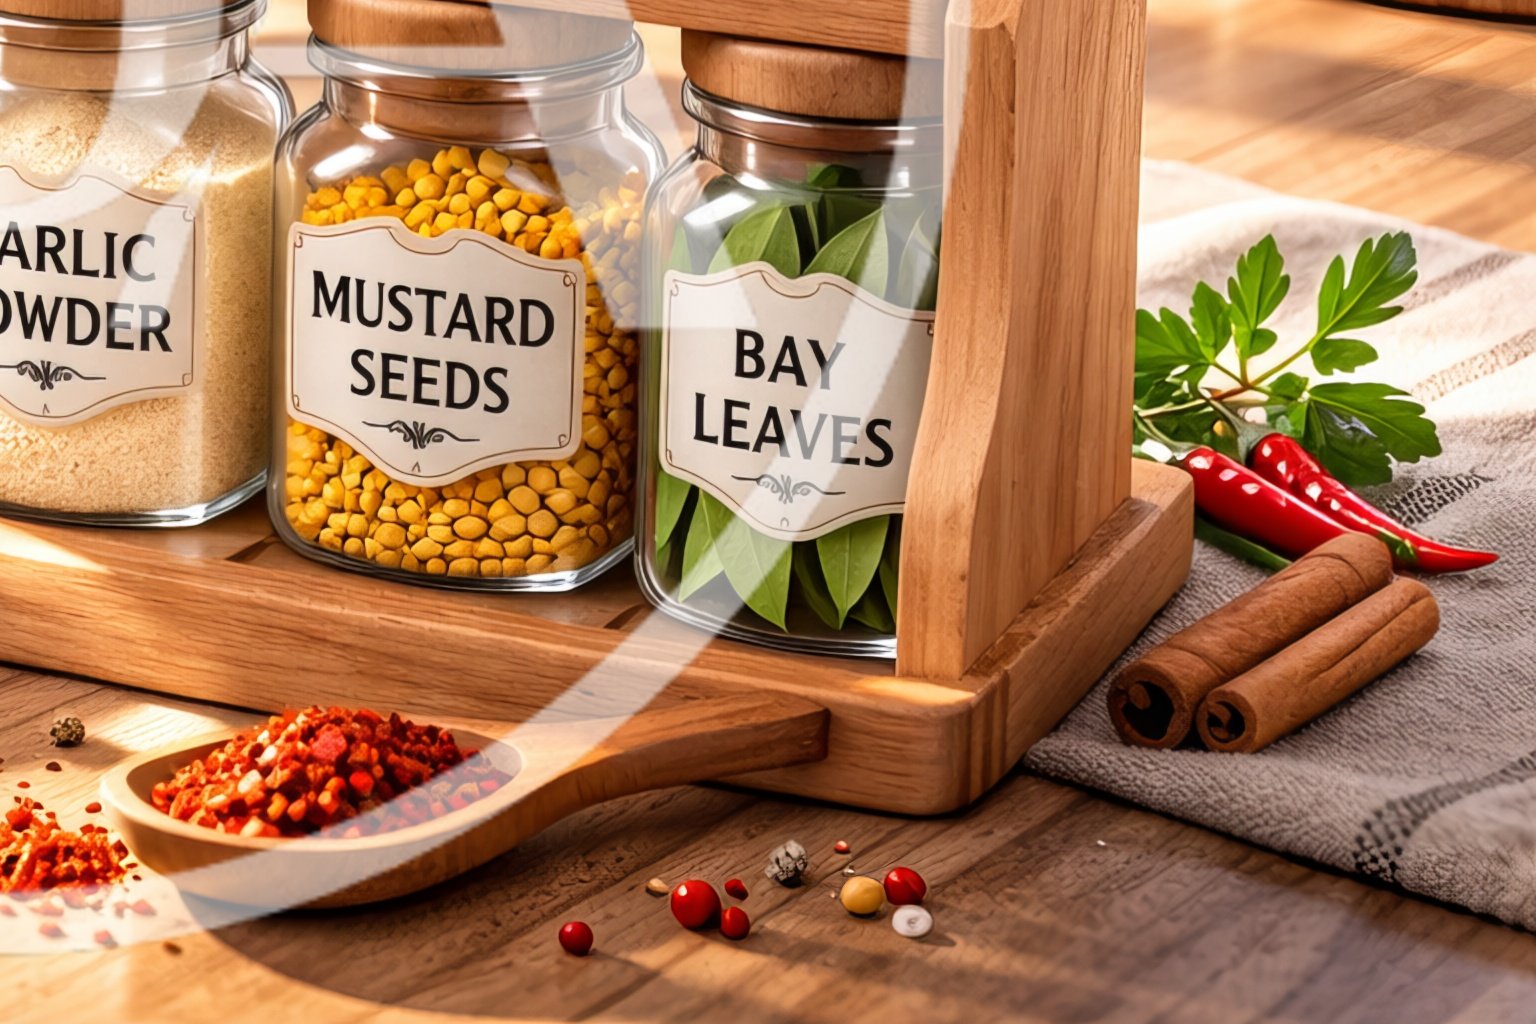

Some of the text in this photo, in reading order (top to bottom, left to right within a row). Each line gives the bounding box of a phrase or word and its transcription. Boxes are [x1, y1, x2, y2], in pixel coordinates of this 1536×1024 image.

[312, 270, 555, 348] MUSTARD
[350, 349, 509, 414] SEEDS
[734, 328, 846, 390] BAY
[693, 392, 894, 468] LEAVES
